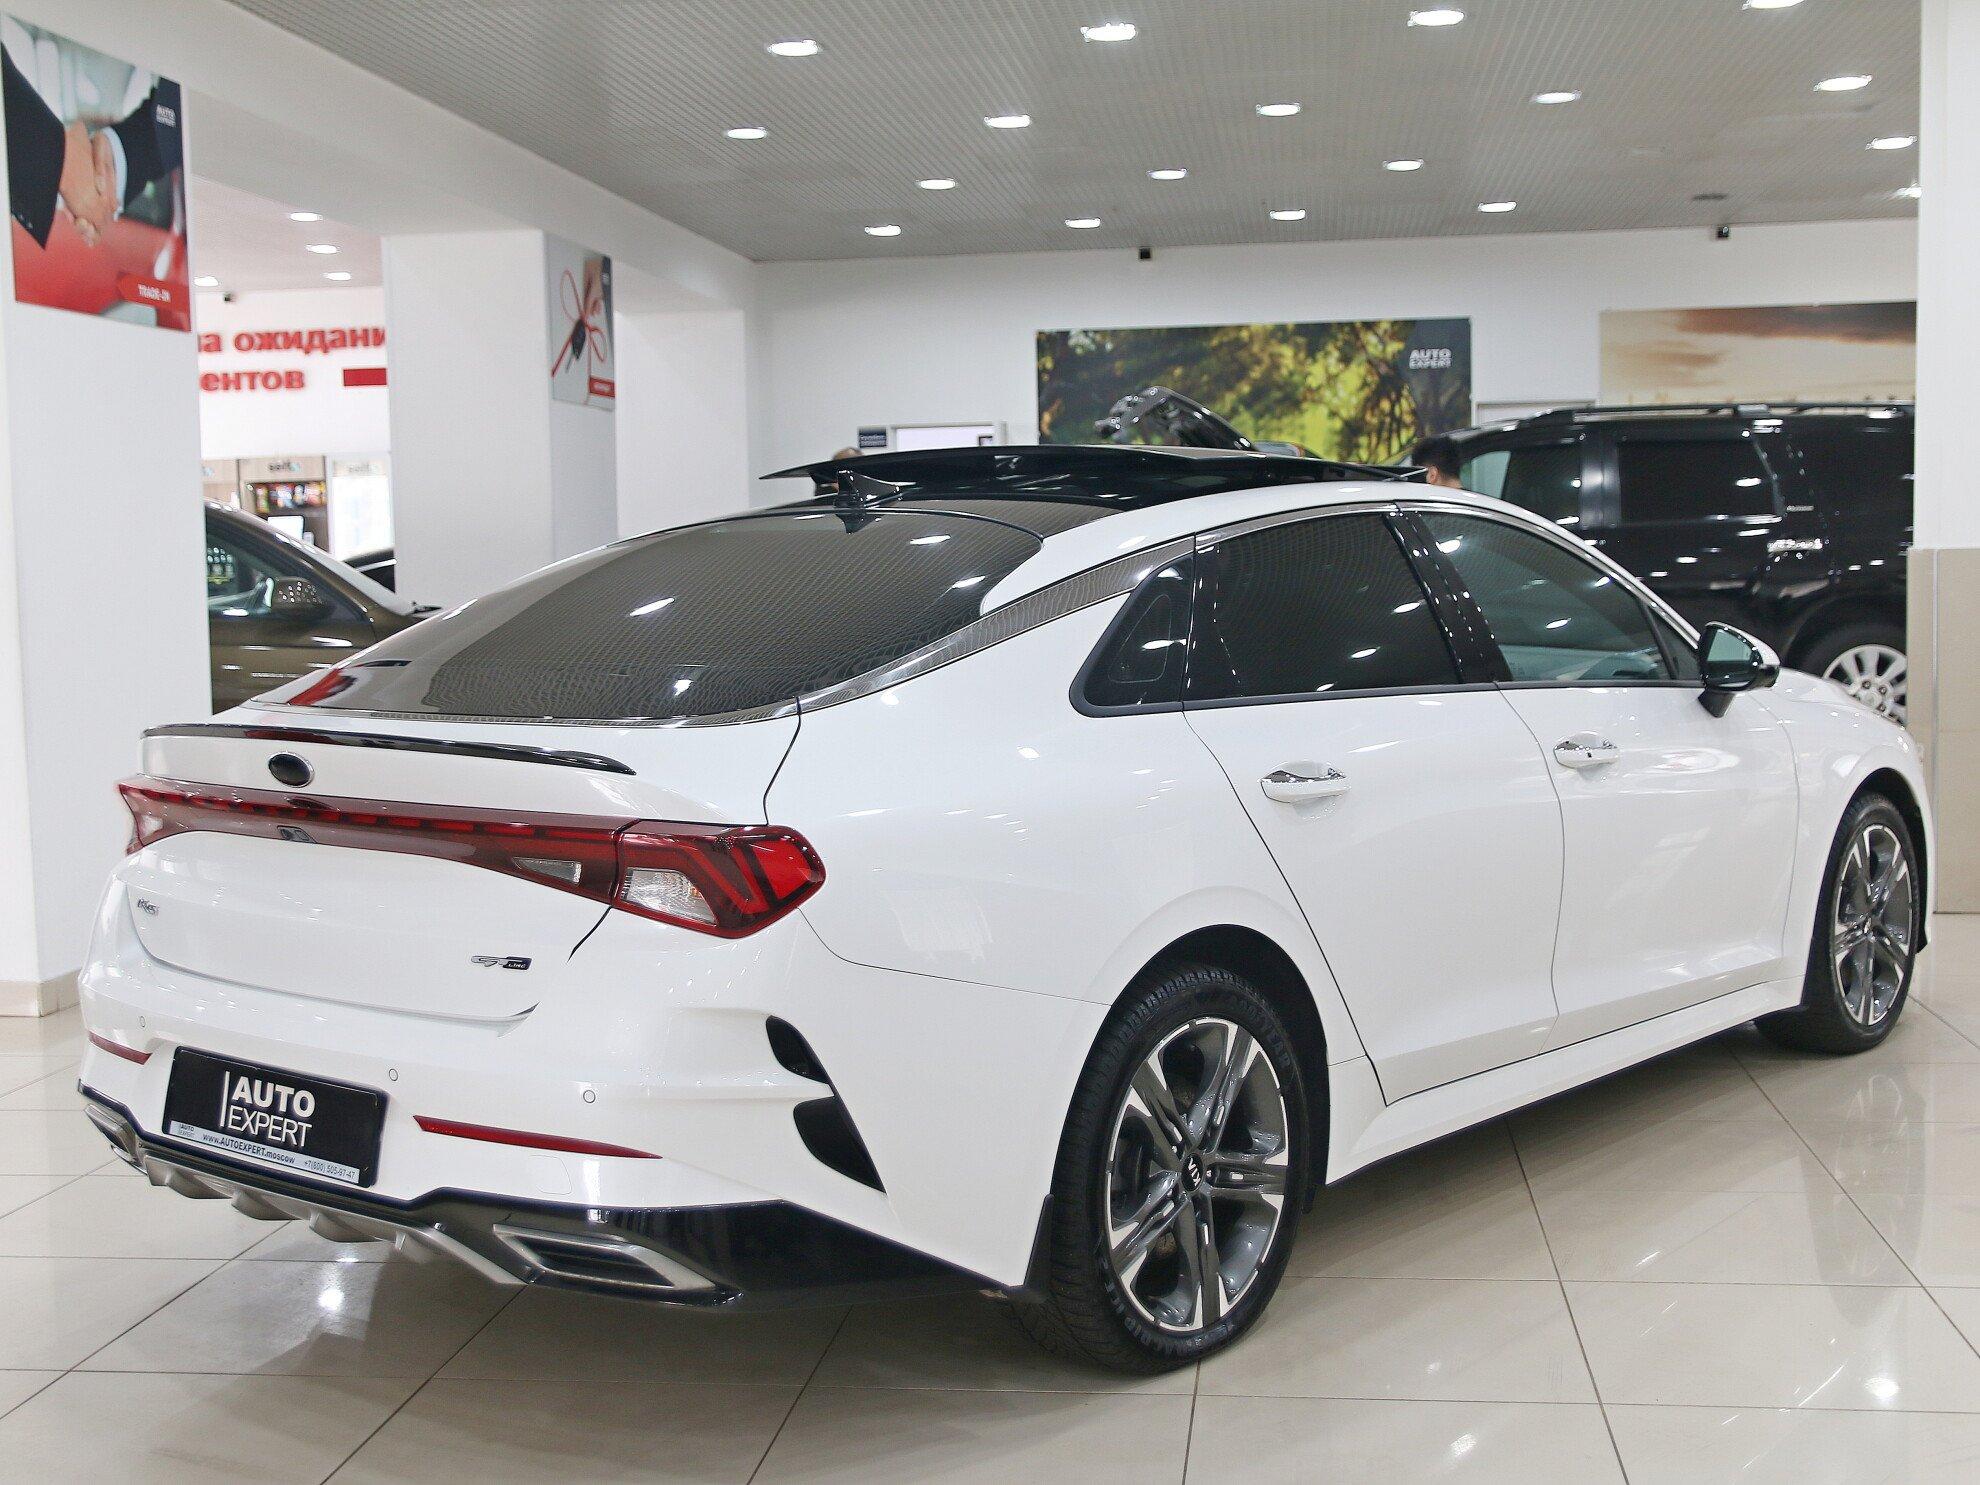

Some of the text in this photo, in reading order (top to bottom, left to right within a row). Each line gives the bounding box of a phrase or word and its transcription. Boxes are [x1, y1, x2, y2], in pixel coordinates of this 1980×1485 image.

[198, 333, 222, 352] а
[1410, 348, 1451, 359] AUTO
[231, 1075, 315, 1117] AUTO
[227, 1104, 312, 1147] EXPERT
